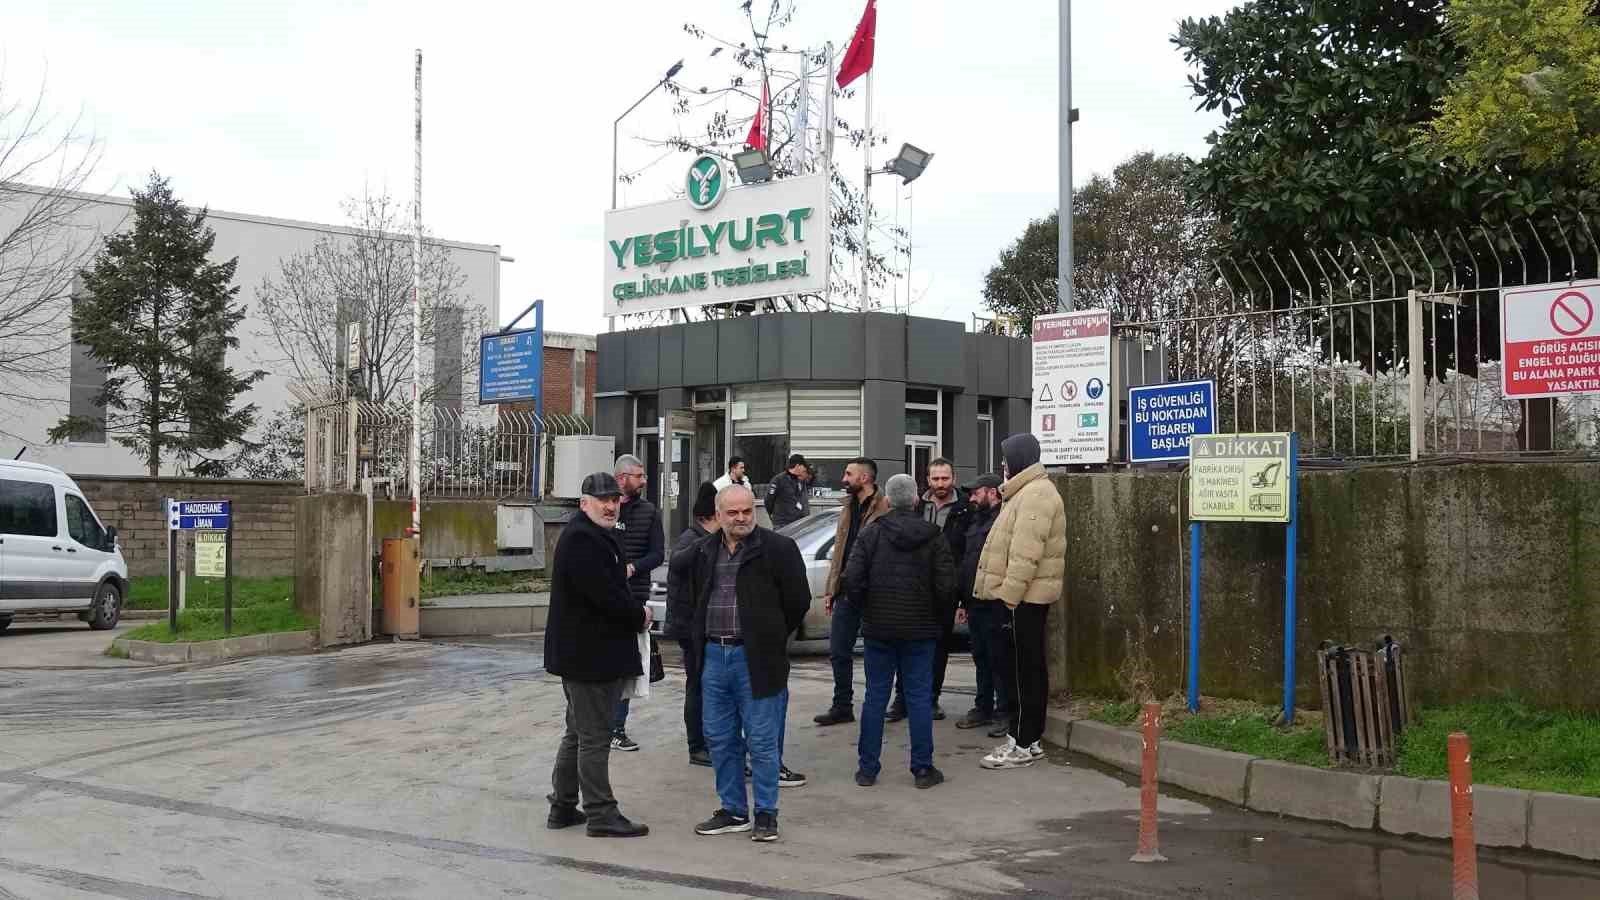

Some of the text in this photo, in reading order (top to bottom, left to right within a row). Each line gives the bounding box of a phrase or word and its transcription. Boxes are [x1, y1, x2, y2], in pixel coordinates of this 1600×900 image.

[608, 207, 814, 272] YEŞİLYURT
[613, 250, 810, 307] ÇELİKHANE TESİSLERİ
[1533, 341, 1600, 354] GÖRÜŞ AÇISI
[1519, 352, 1600, 368] ENGEL OLDUĞU
[1513, 371, 1526, 381] BU
[1529, 368, 1565, 380] ALANA
[1567, 366, 1595, 377] PARK
[1547, 380, 1600, 391] YASAKTIR
[1137, 391, 1204, 411] İŞ GÜVENLİĞİ
[1135, 406, 1207, 424] BU NOKTADAN
[1148, 422, 1195, 437] İTİBAREN
[1215, 439, 1283, 456] DİKKAT
[185, 503, 223, 514] HADDEHANE
[194, 517, 213, 528] LİMAN
